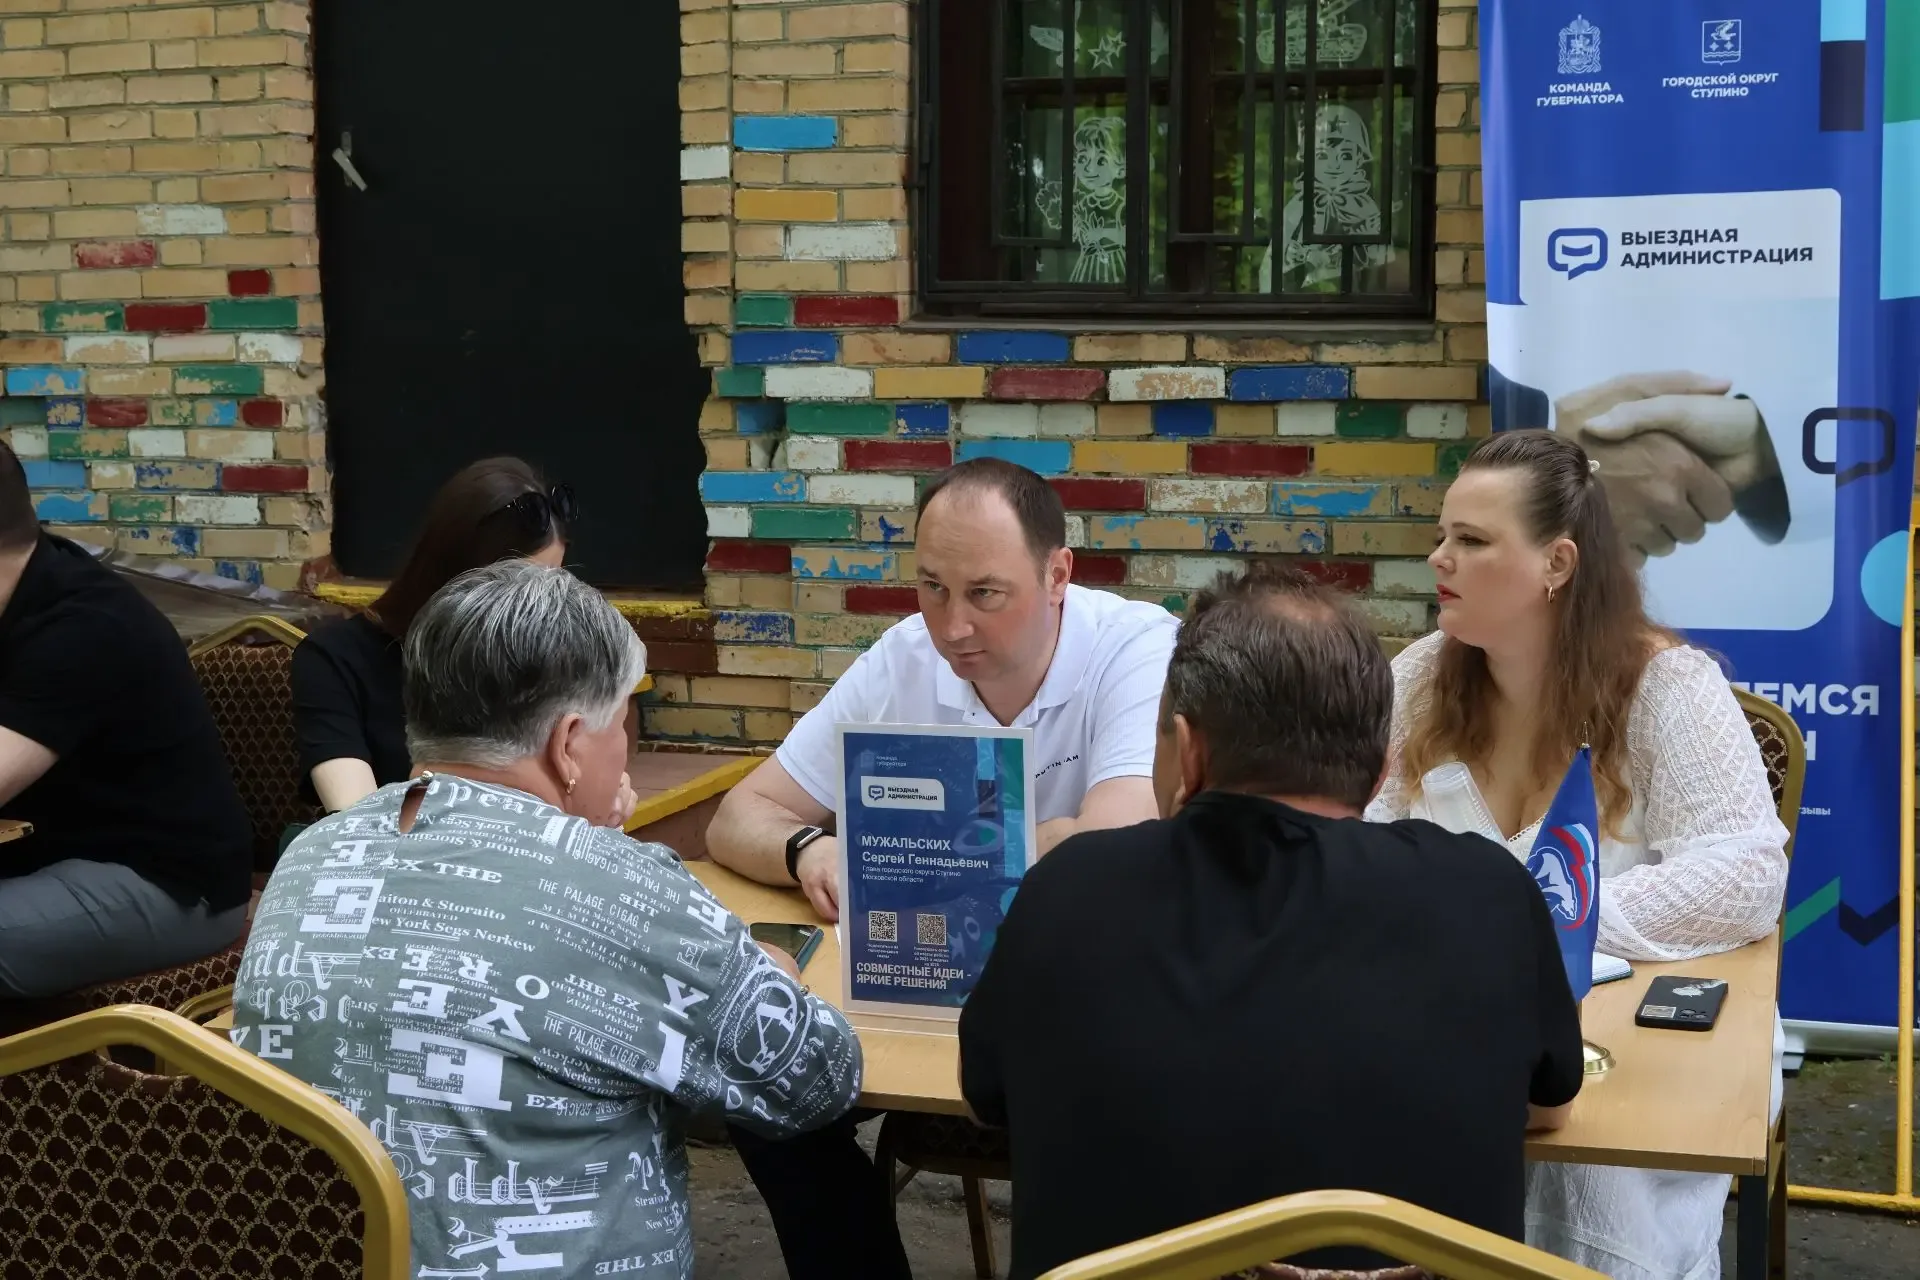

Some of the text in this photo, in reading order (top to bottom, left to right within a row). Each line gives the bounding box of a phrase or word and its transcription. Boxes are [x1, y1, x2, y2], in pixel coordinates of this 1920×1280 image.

[1549, 81, 1611, 93] КОМАНДА
[1662, 72, 1779, 88] ГОРОДСКОЙ ОКРУГ
[1536, 93, 1624, 107] ГУБЕРНАТОРА
[1691, 86, 1749, 98] СТУПИНО
[1620, 228, 1739, 246] ВЫЕЗДНАЯ
[1620, 247, 1813, 267] АДМИНИСТРАЦИЯ
[887, 793, 938, 801] АДМИНИСТРАЦИЯ
[861, 835, 951, 851] МУЖАЛЬСКИХ
[862, 851, 989, 869] Сергей Геннадьевич
[433, 862, 503, 884] THE
[537, 878, 559, 896] THE
[664, 886, 682, 905] THE
[421, 898, 435, 909] &
[438, 900, 506, 922] Storaito
[395, 917, 431, 931] York
[434, 921, 470, 938] Segs
[474, 928, 536, 953] Nerkew
[856, 961, 931, 977] СОВМЕСТНЫЕ
[933, 967, 964, 979] ИДЕИ
[856, 974, 947, 989] ЯРКИЕ РЕШЕНИЯ
[543, 1015, 565, 1037] THE
[595, 1255, 646, 1276] THE
